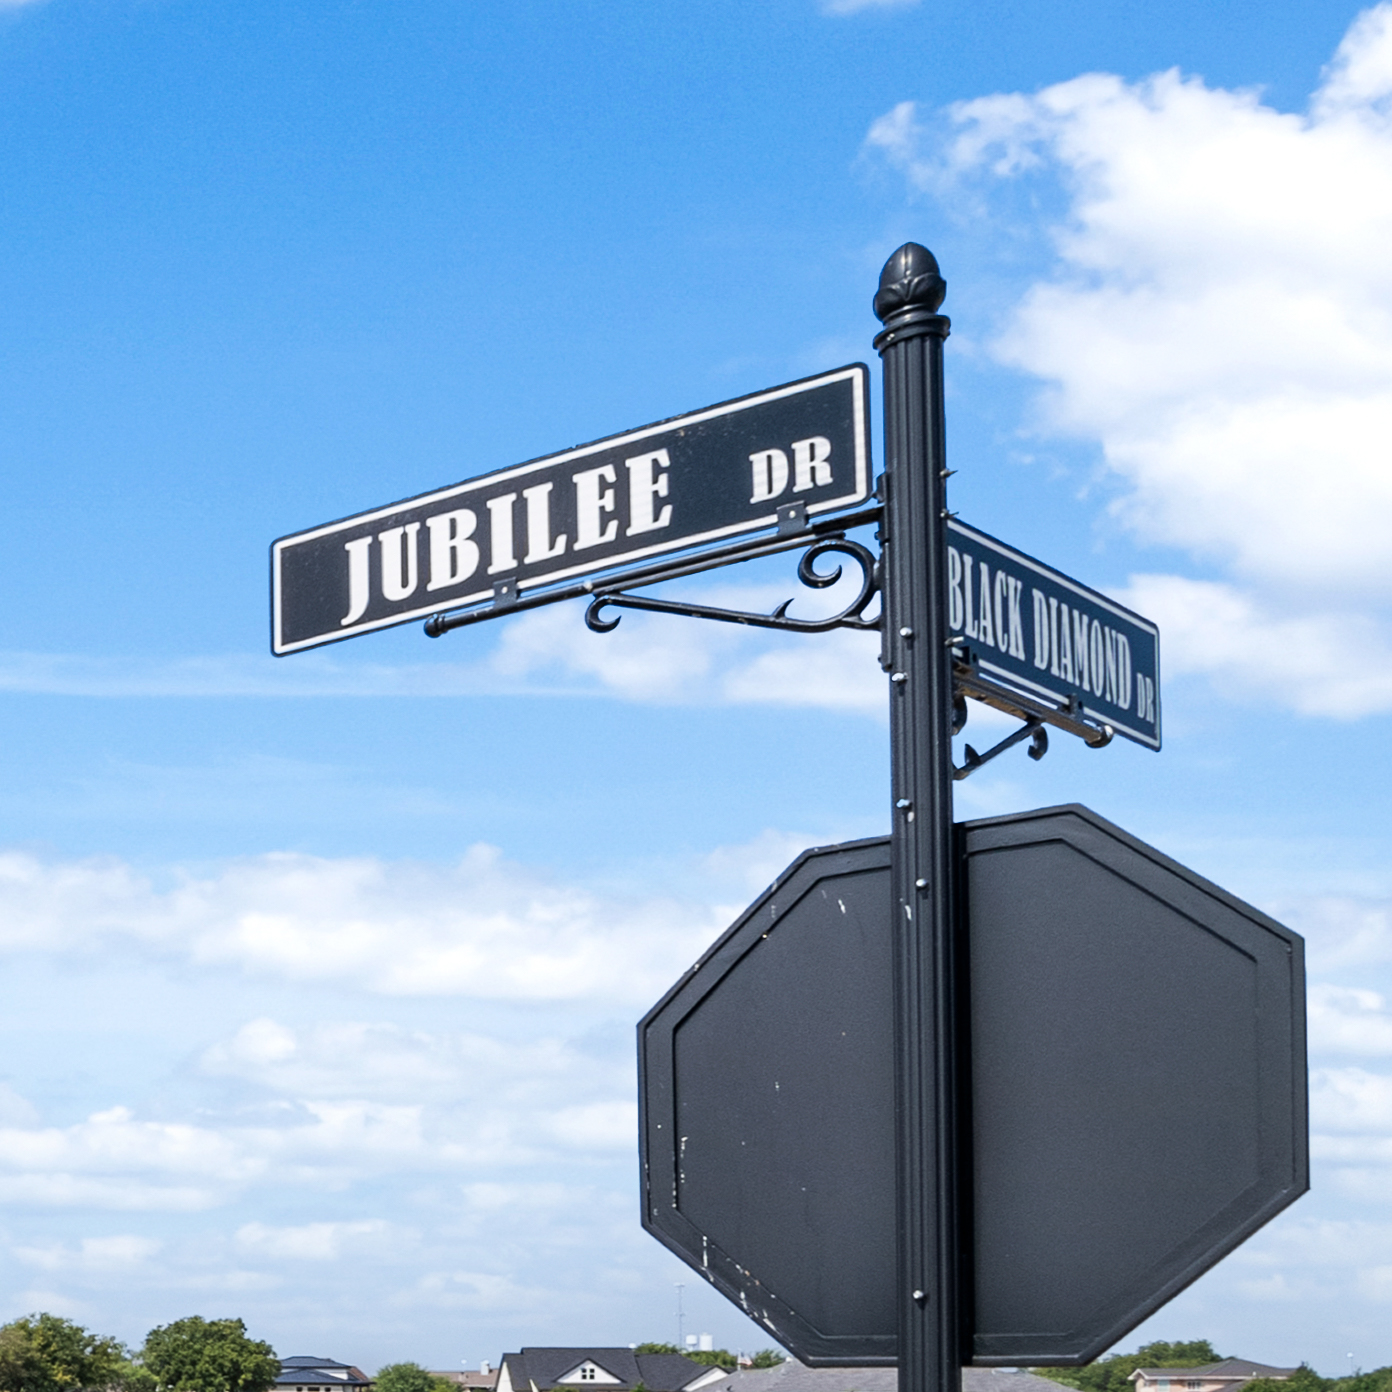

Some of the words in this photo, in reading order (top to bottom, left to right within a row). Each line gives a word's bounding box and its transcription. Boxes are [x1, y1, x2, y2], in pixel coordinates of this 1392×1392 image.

[341, 448, 673, 626] JUBILEE
[749, 435, 834, 506] DR
[948, 546, 1025, 661] BLACK
[1032, 588, 1132, 710] DIAMOND
[1137, 672, 1155, 724] DR
